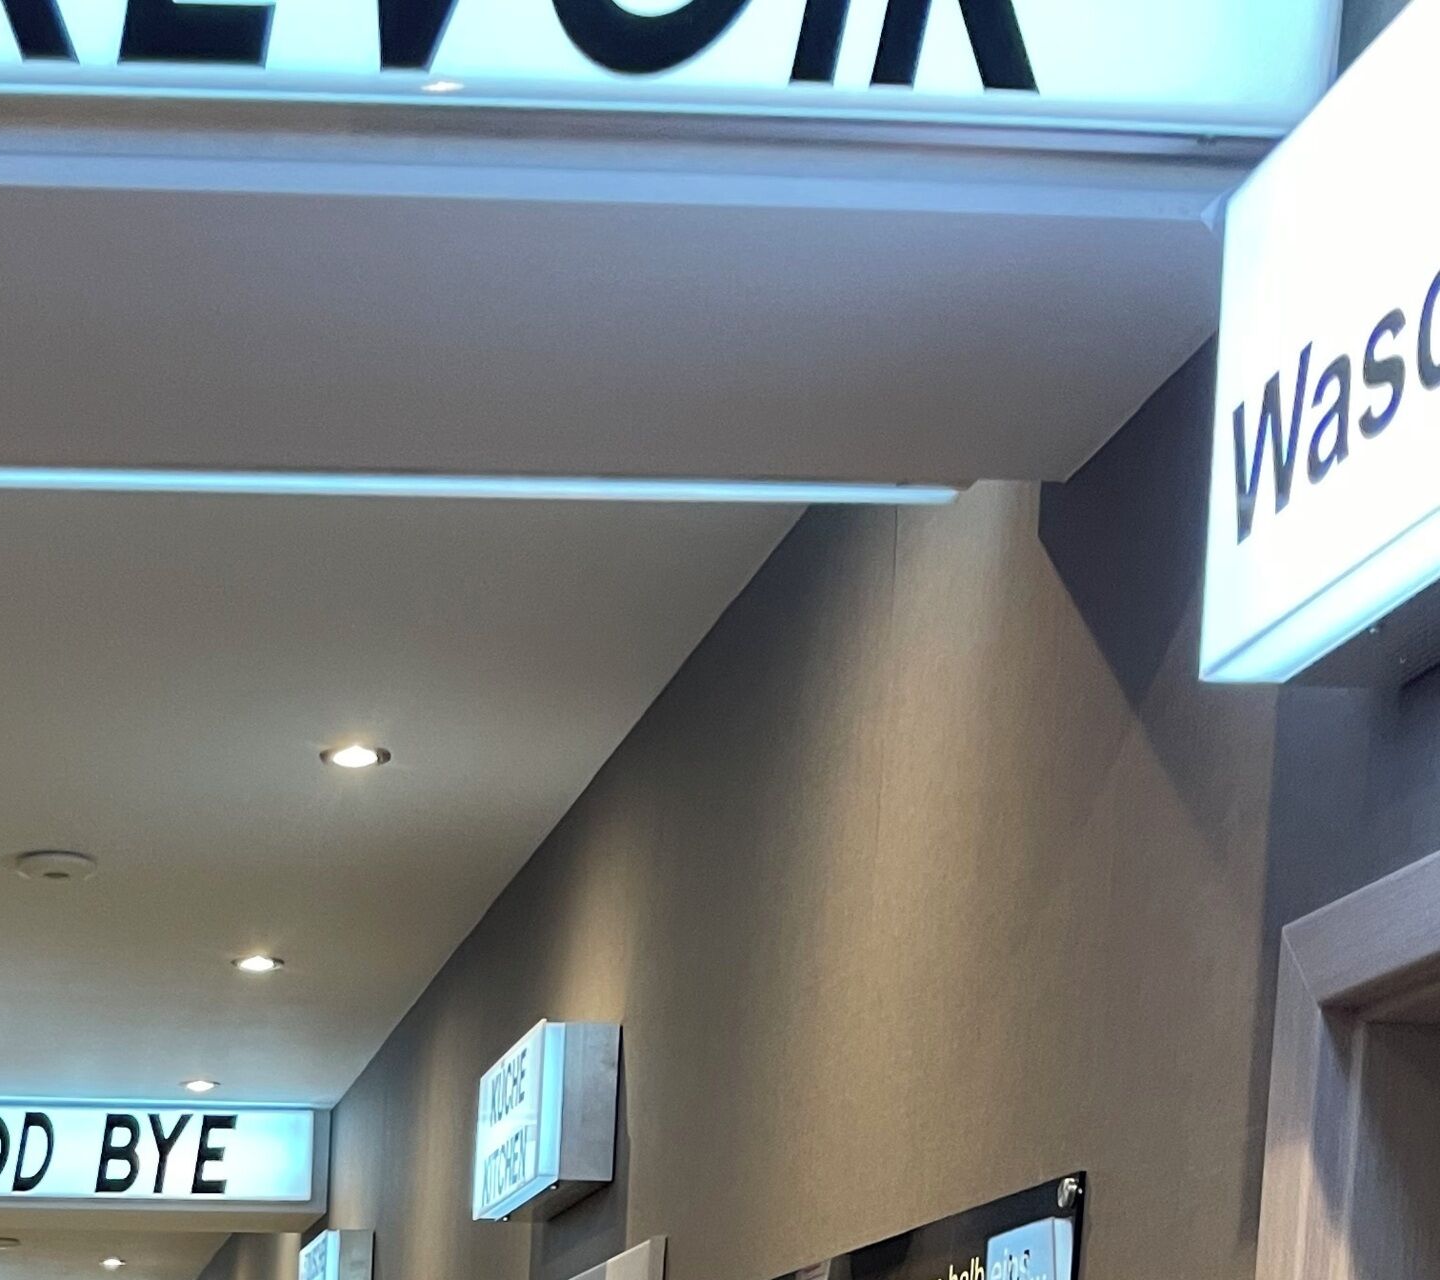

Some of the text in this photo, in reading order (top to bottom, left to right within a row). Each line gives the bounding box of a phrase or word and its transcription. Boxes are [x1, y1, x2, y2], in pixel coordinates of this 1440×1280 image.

[490, 1047, 527, 1125] KÜCHE
[94, 1112, 238, 1194] BYE
[482, 1126, 527, 1206] KITCHEN
